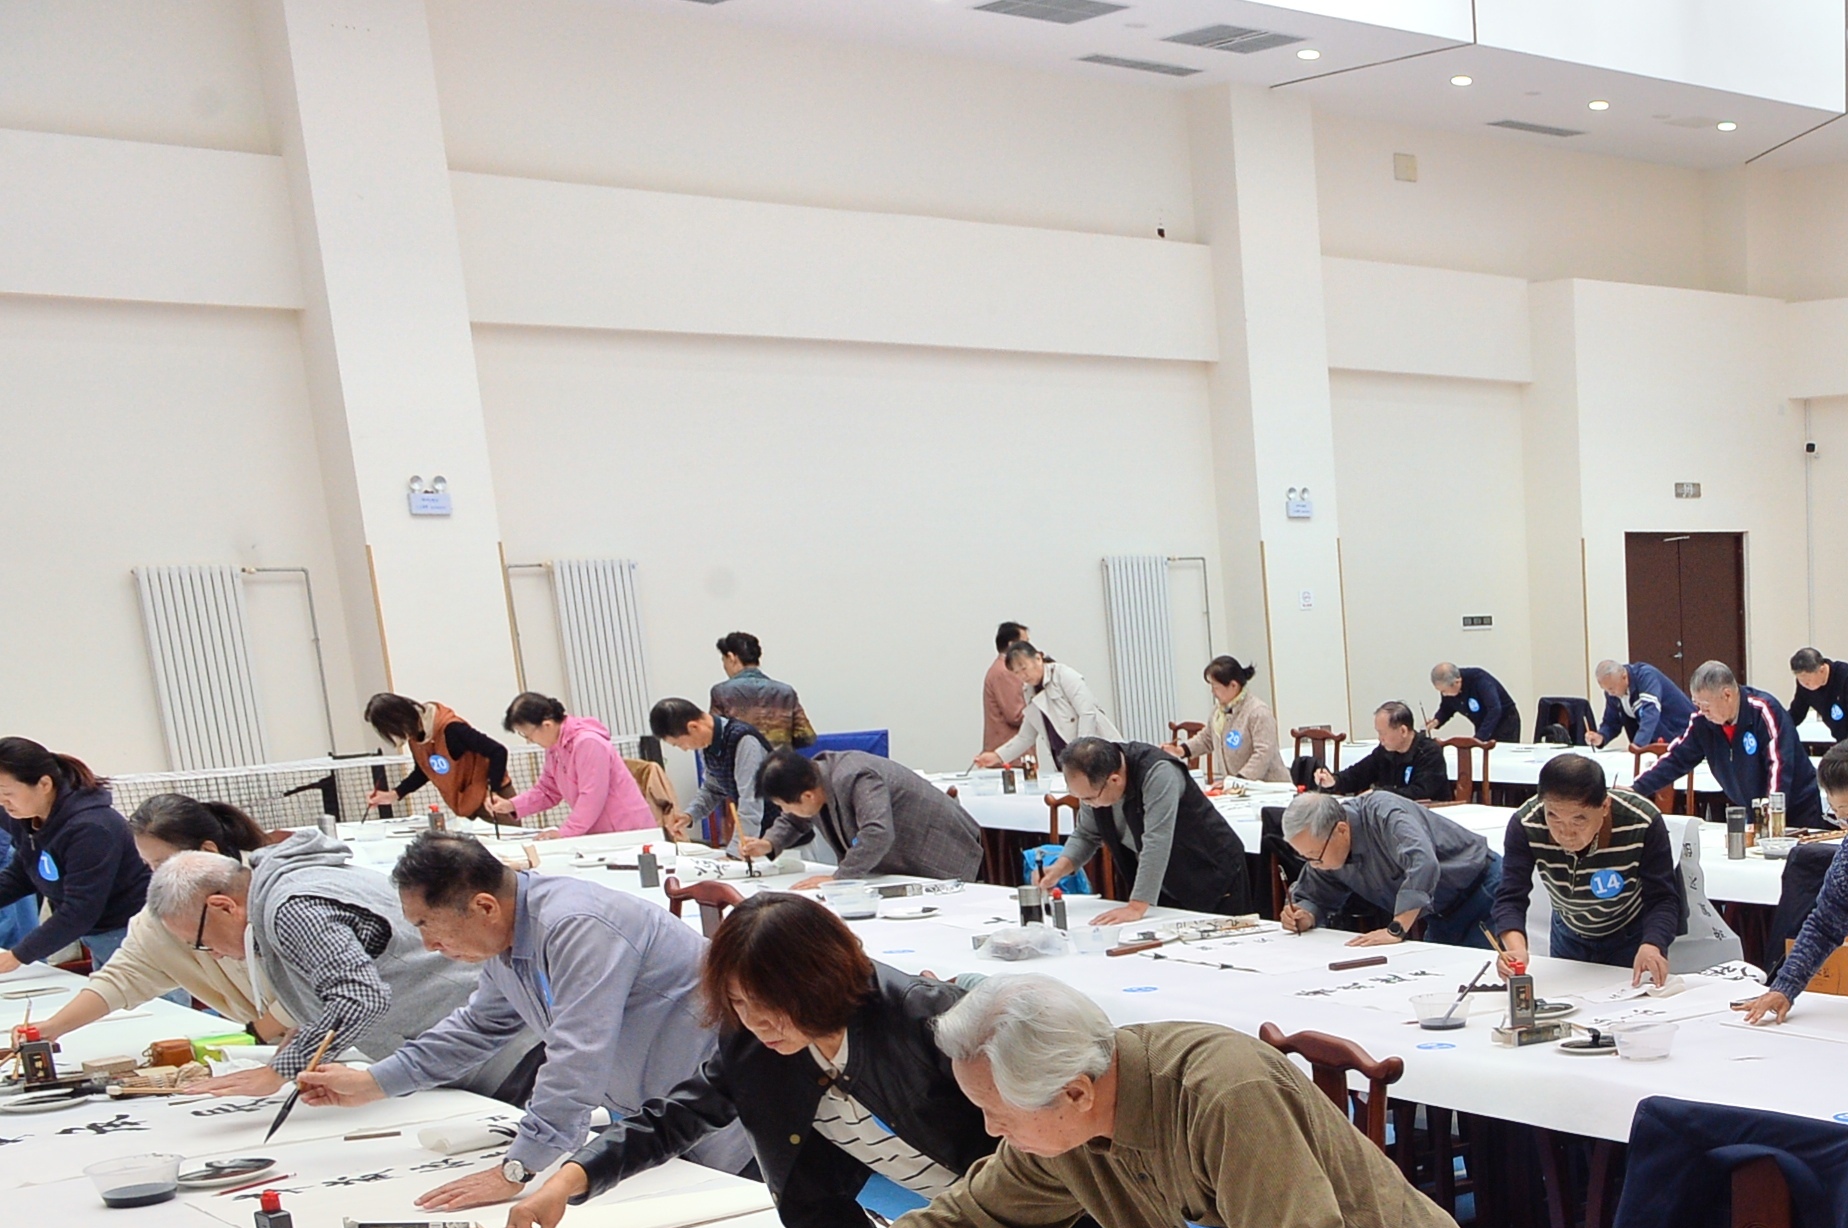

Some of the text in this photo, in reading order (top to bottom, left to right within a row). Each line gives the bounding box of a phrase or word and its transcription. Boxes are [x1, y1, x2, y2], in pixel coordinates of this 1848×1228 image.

[1226, 731, 1240, 746] 29
[431, 756, 447, 771] 20
[1594, 874, 1620, 895] 14
